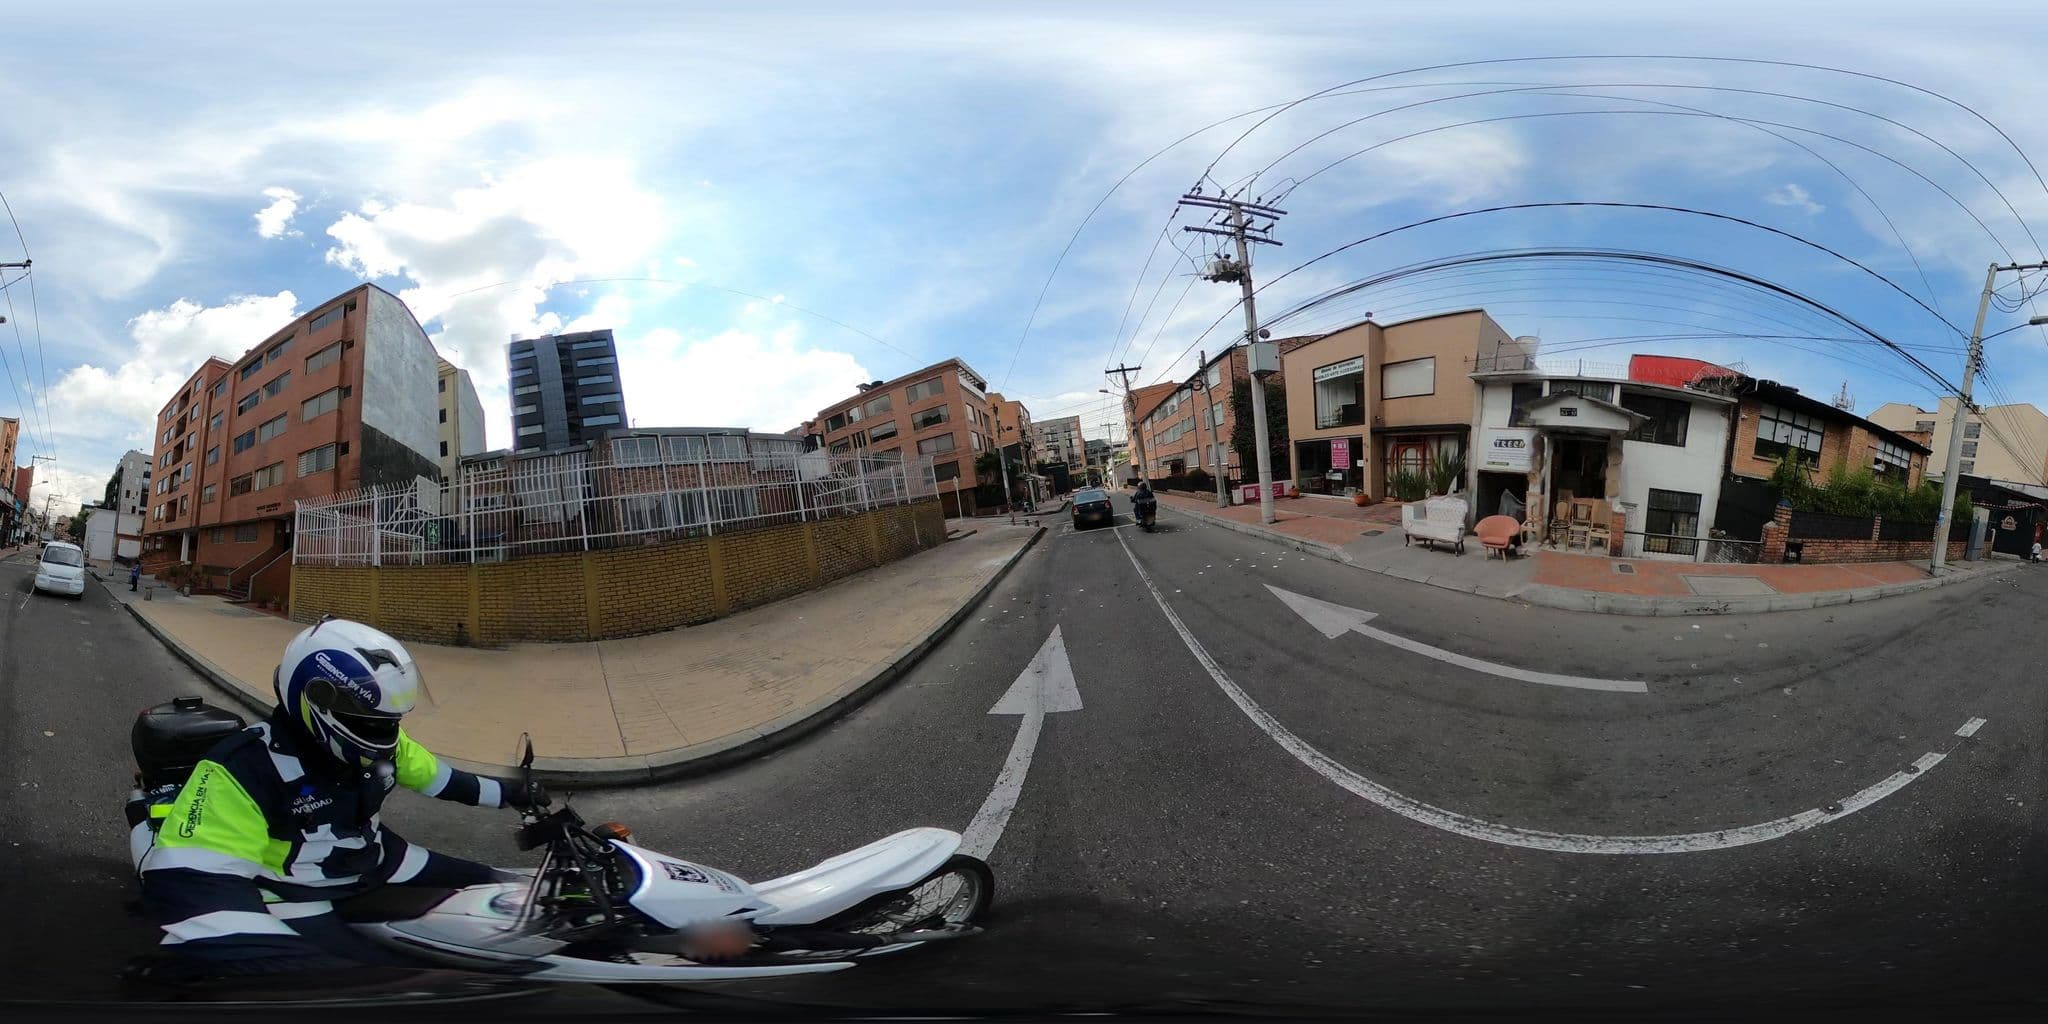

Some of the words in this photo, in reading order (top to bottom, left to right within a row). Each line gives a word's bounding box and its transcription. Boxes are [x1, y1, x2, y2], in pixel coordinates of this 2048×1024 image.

[315, 652, 349, 683] GERENCIA
[347, 679, 360, 691] EN
[179, 799, 201, 838] GERENCIA
[196, 786, 204, 798] EN
